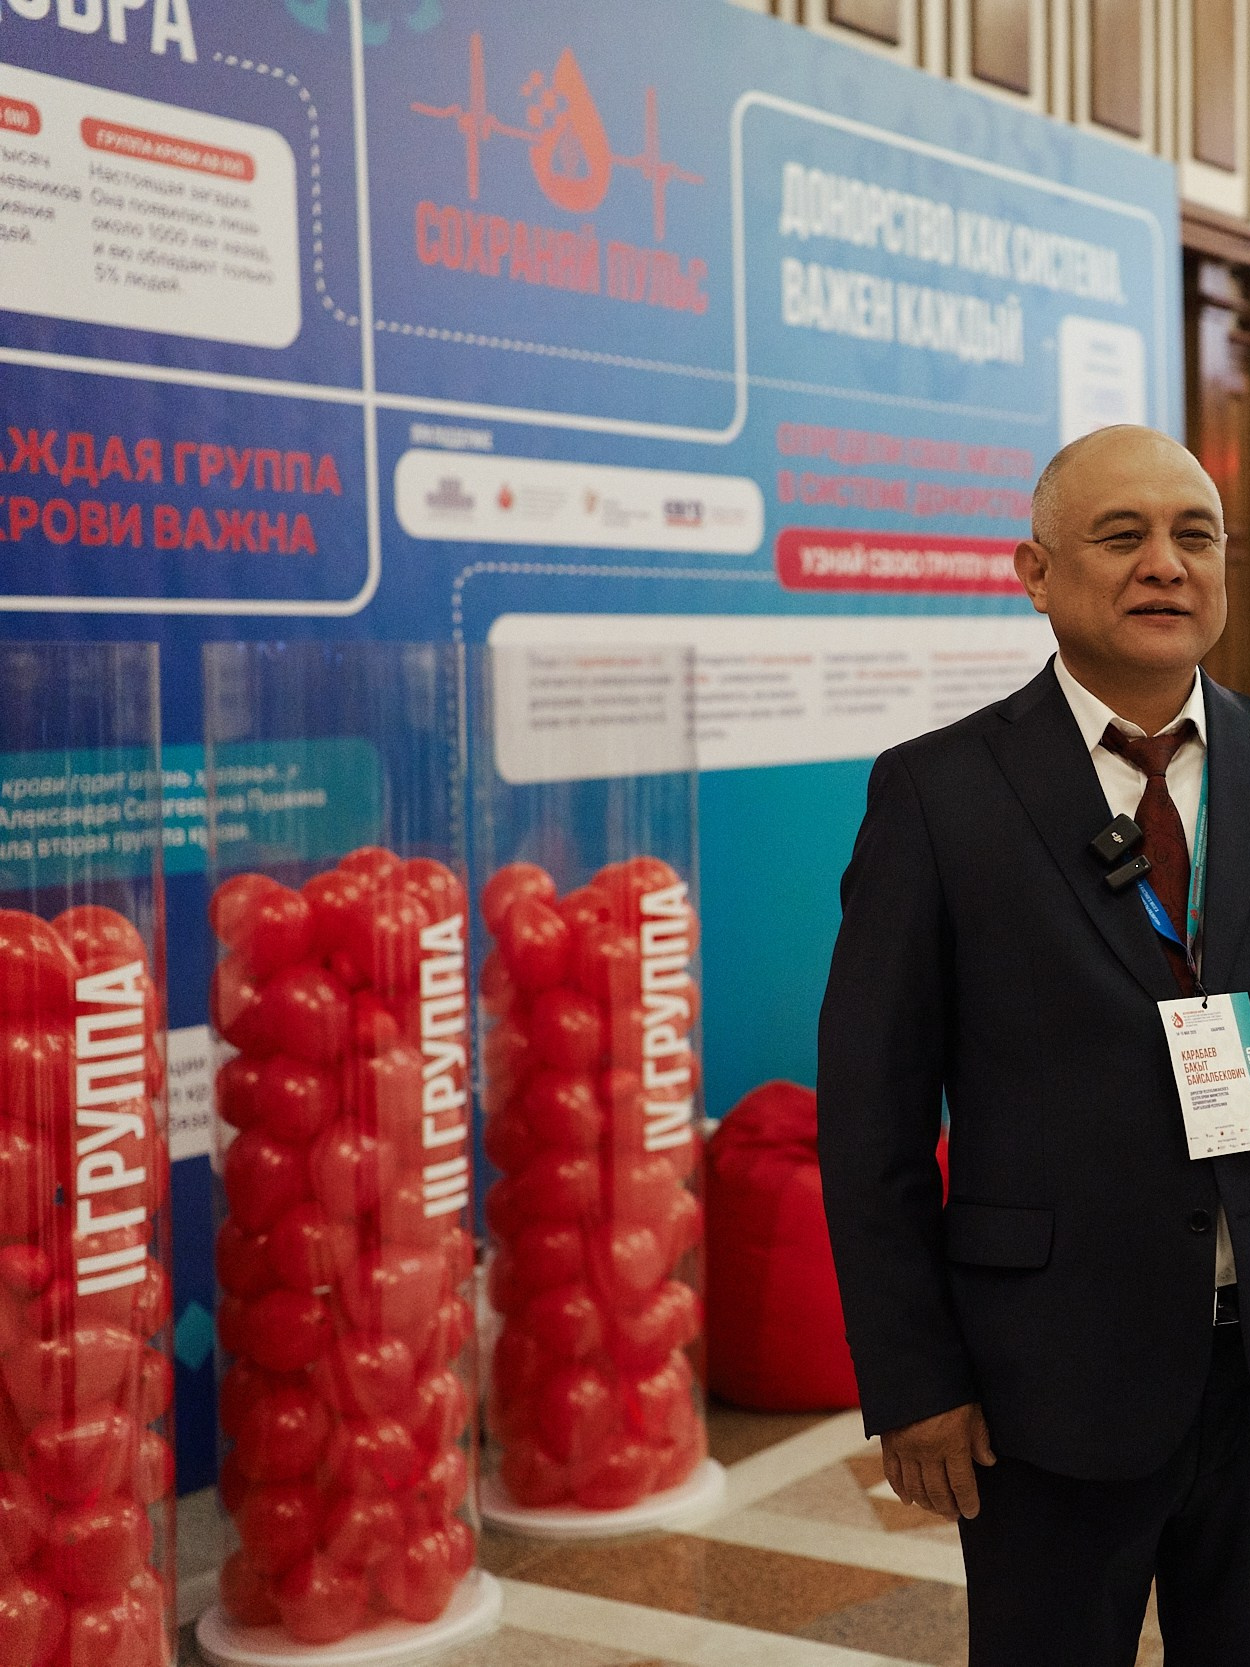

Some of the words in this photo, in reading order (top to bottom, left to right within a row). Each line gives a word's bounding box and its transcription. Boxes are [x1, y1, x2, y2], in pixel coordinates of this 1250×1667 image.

[779, 160, 954, 269] ДОНОРСТВО
[956, 206, 1011, 281] КАК
[782, 255, 895, 343] ВАЖЕН
[896, 280, 1025, 367] КАЖДЫЙ
[0, 426, 164, 489] ЖДАЯ
[173, 440, 343, 496] ГРУППА
[0, 495, 142, 548] РОВИ
[153, 504, 318, 555] ВАЖНА
[640, 880, 691, 1090] ГРУППА
[419, 912, 468, 1150] ГРУППА
[1181, 1047, 1218, 1062] КАРАБАЕВ
[75, 959, 146, 1237] ГРУППА
[1183, 1060, 1209, 1074] БАКЫТ
[1186, 1067, 1247, 1086] БАЙСАЛБЕКОВИЧ
[643, 1098, 693, 1153] IV
[422, 1155, 469, 1219] III
[76, 1243, 147, 1297] II
